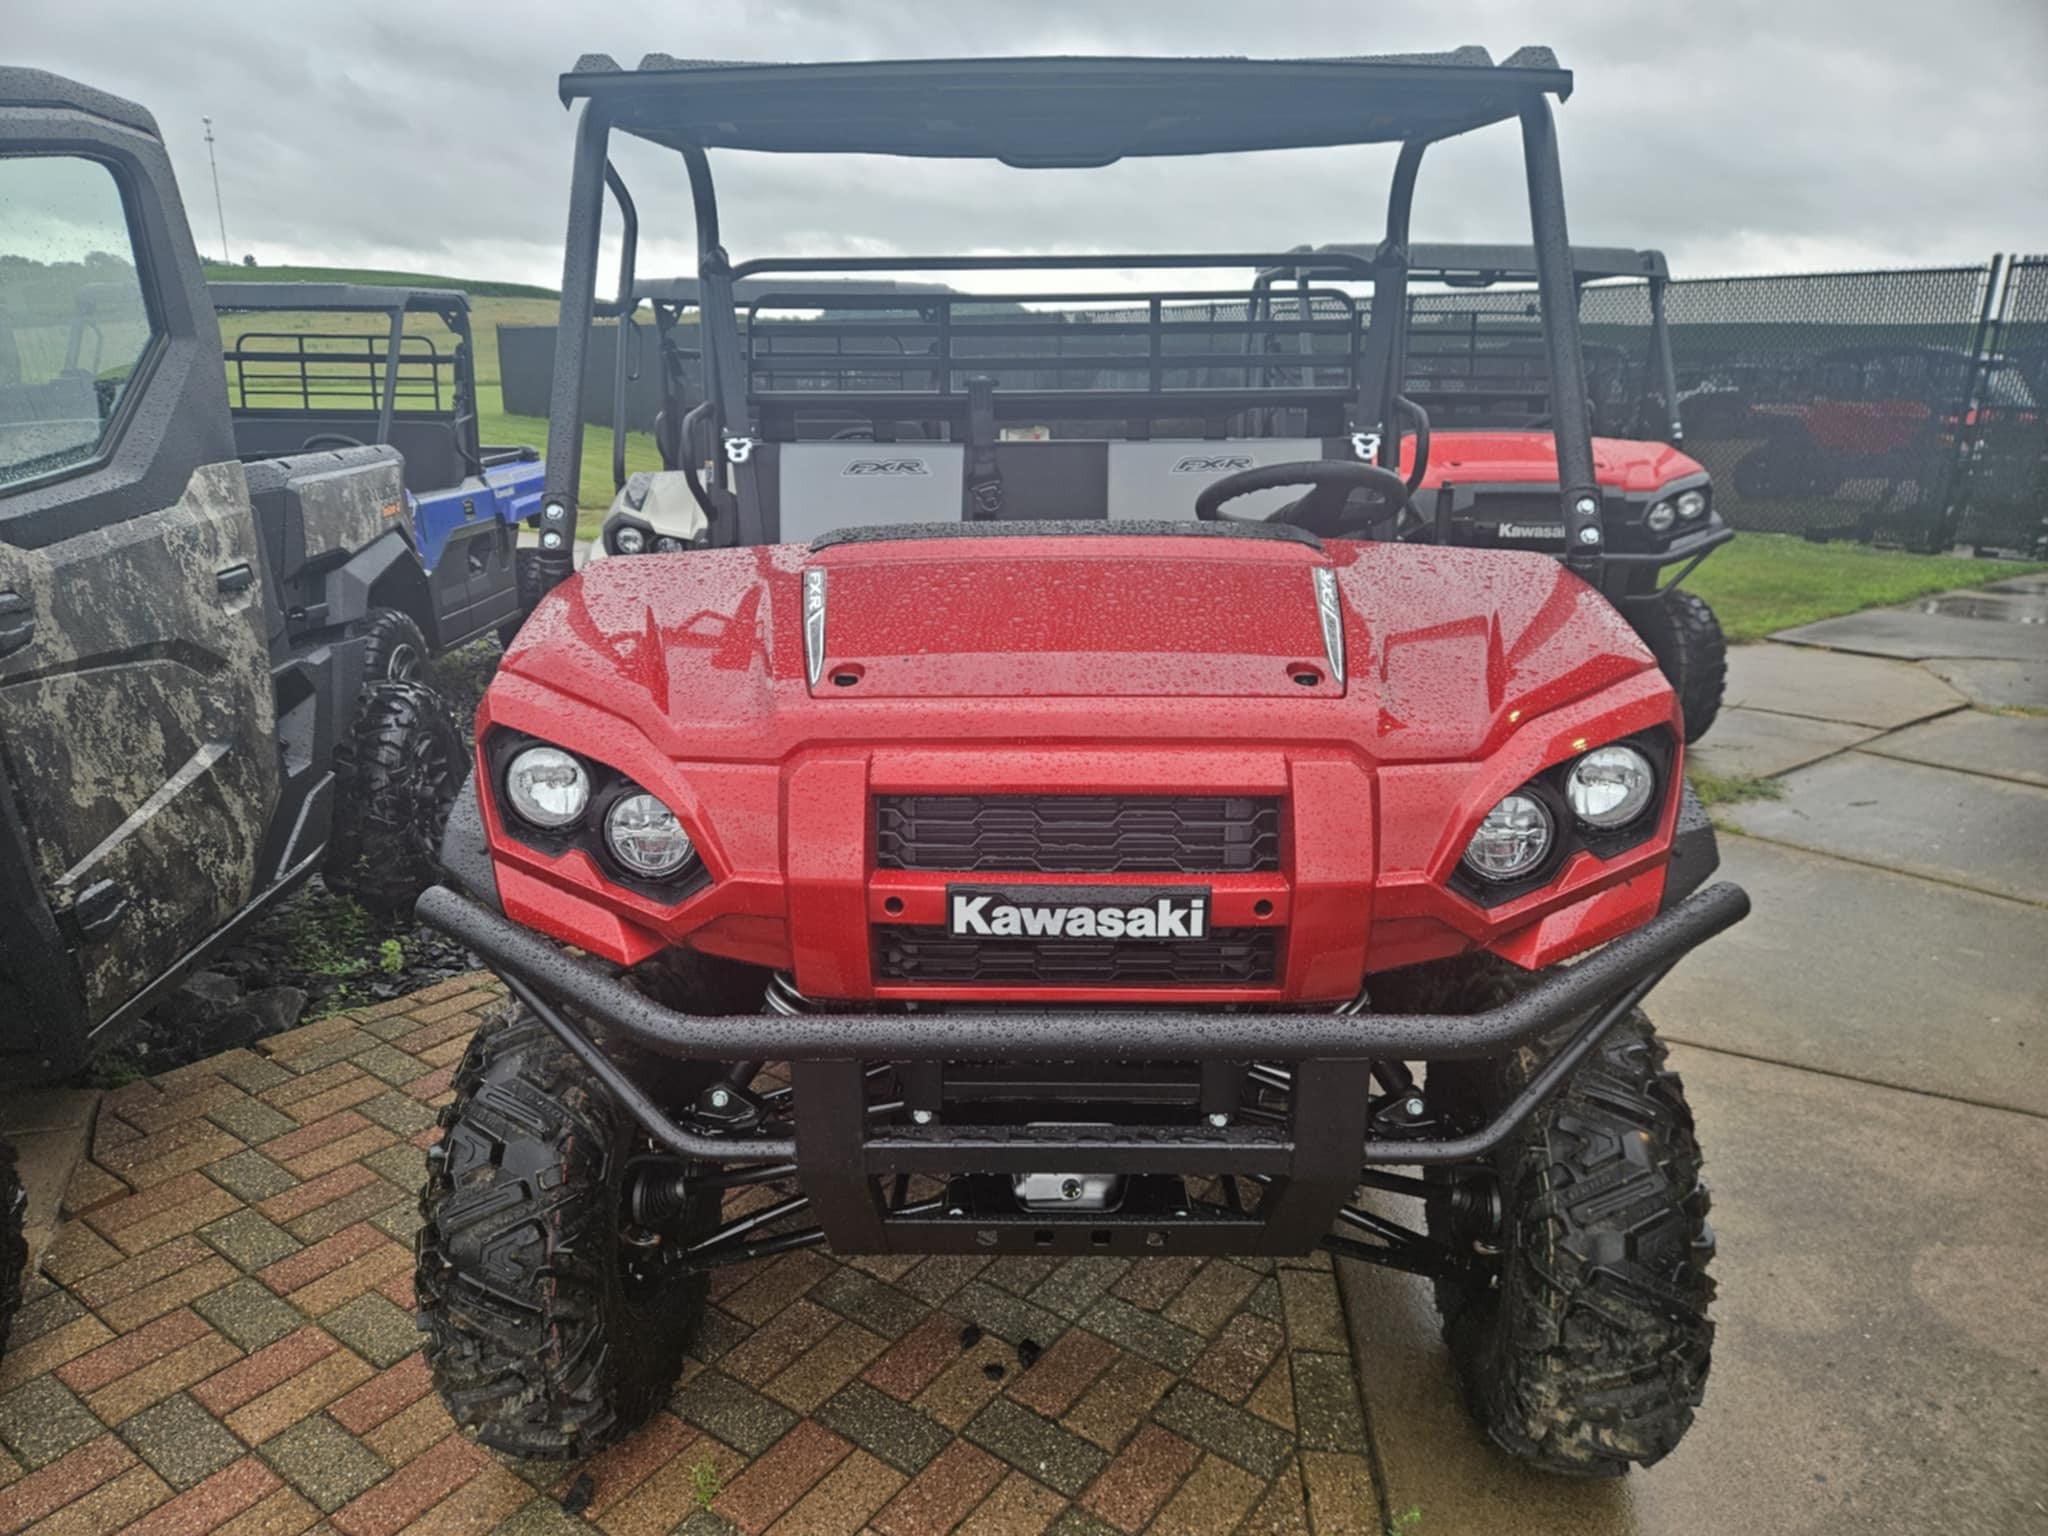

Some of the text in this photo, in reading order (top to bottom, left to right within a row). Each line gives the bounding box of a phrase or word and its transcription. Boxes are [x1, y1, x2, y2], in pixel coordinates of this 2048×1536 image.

[1498, 523, 1566, 538] Kawasa
[809, 571, 822, 610] FXR
[953, 895, 1204, 937] Kawasaki
